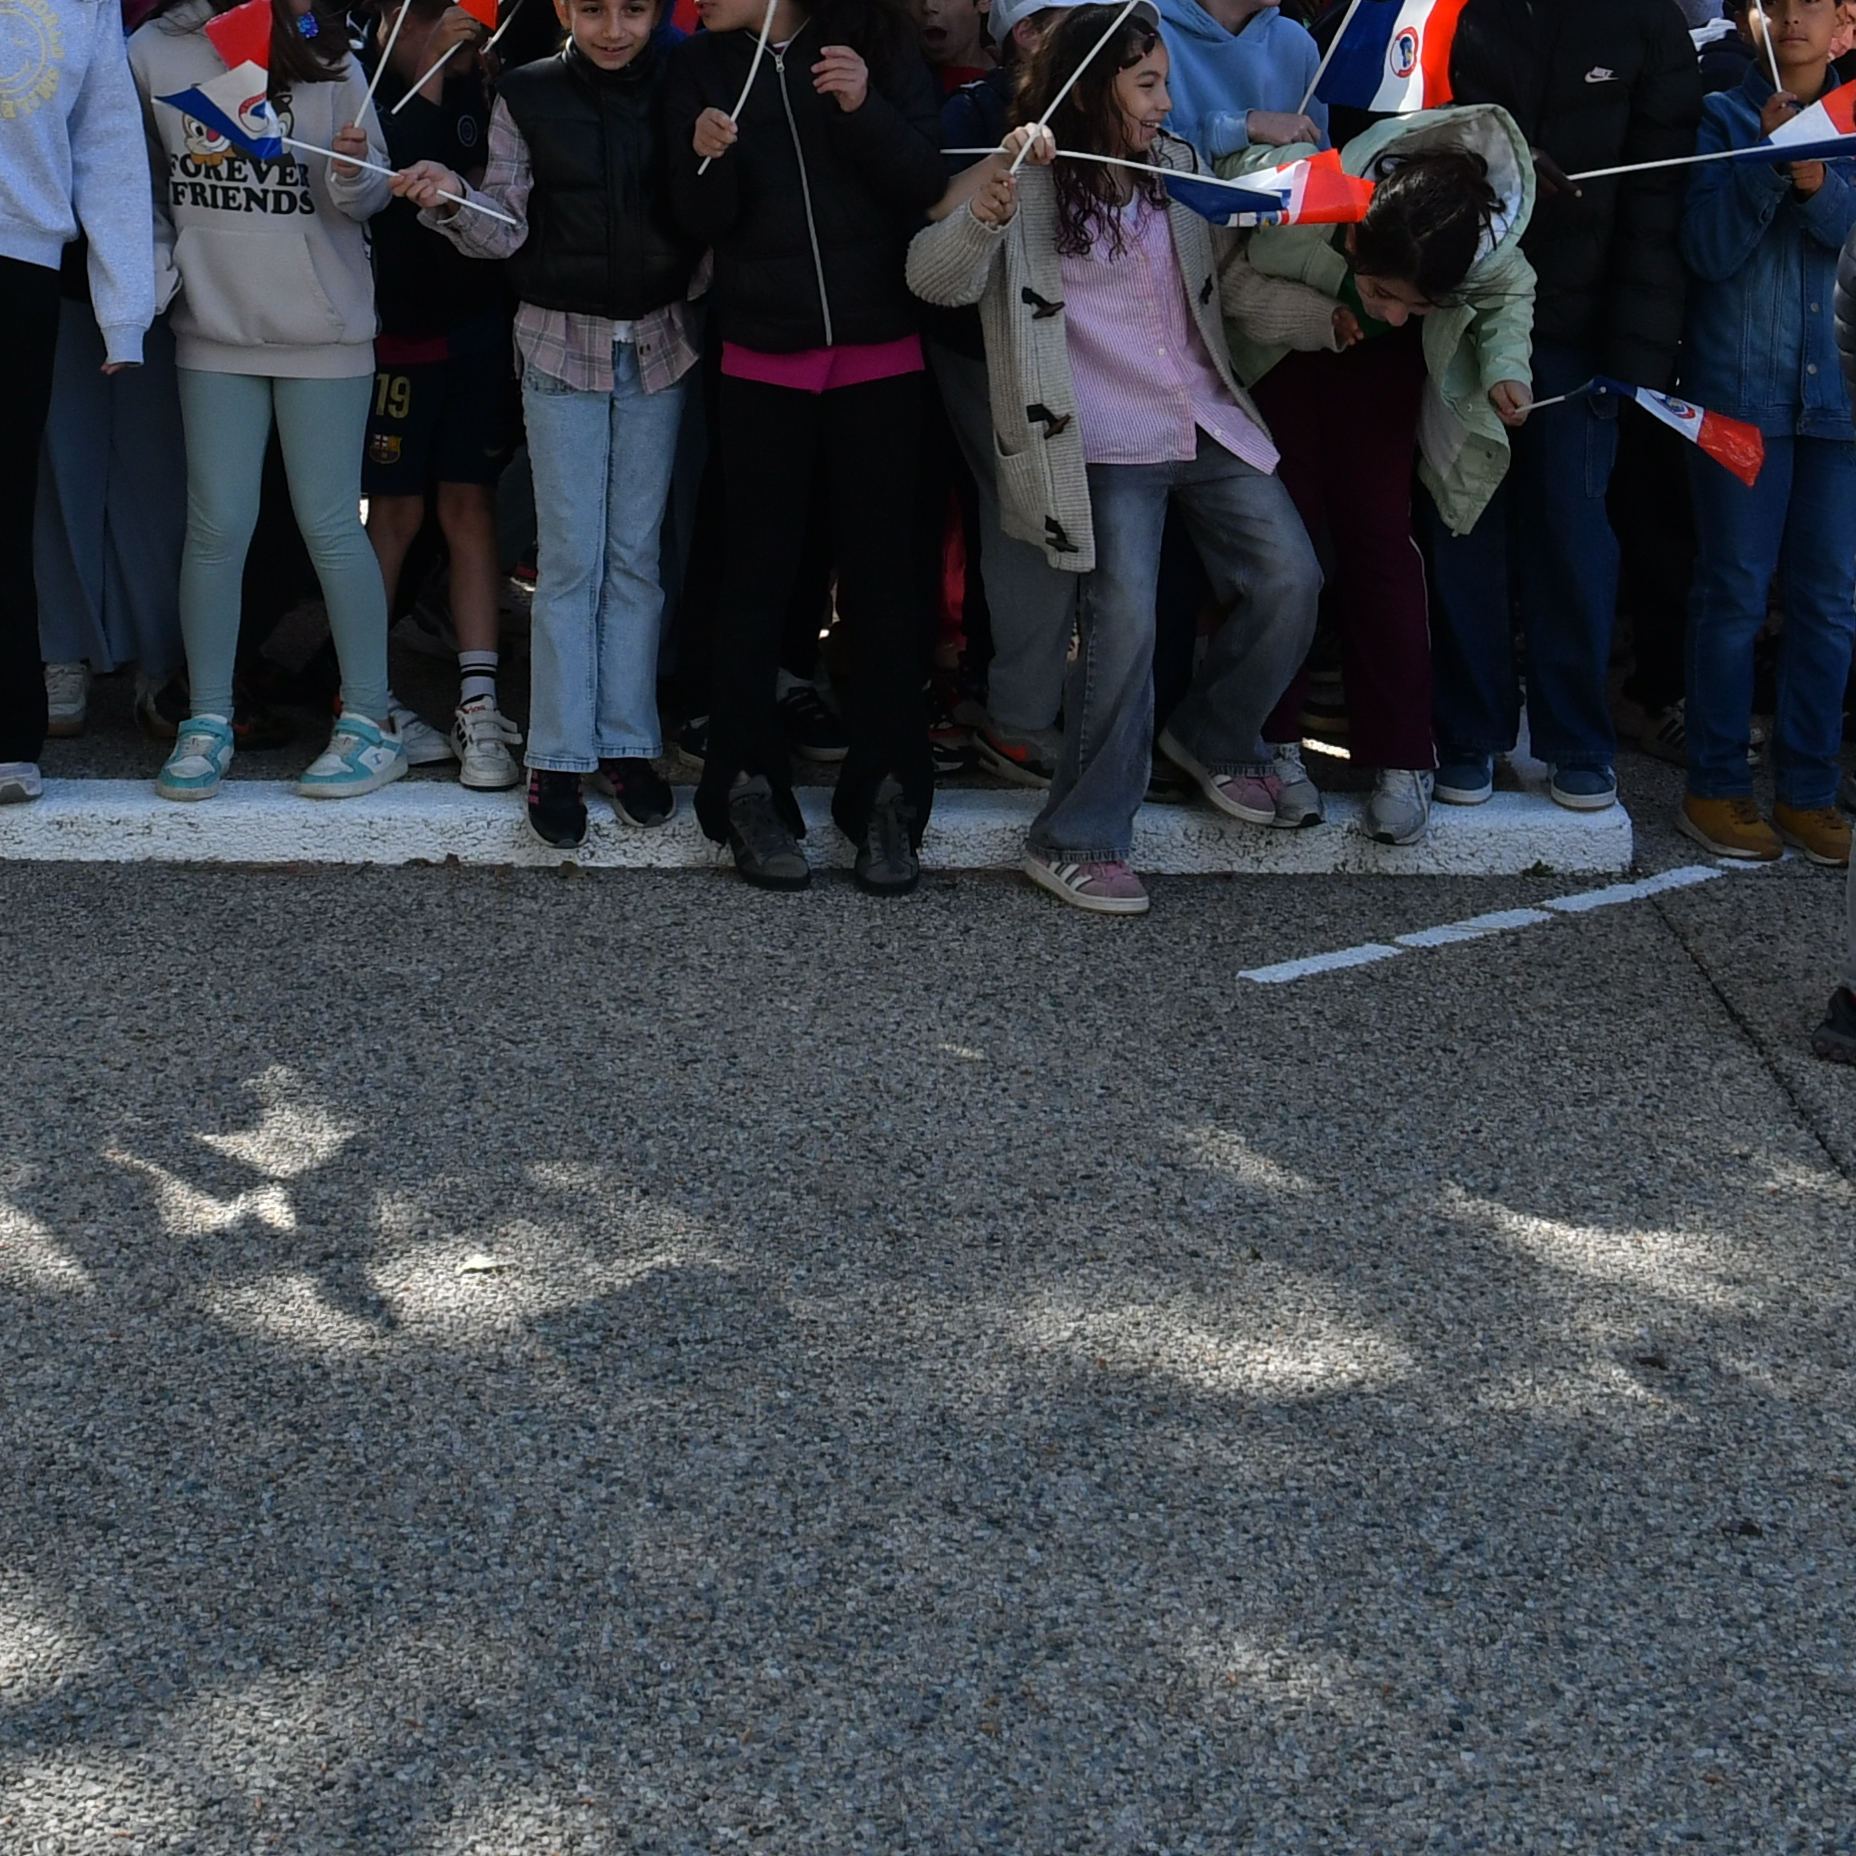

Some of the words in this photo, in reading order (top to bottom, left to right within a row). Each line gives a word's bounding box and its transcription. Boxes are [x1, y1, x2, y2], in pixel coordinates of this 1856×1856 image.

[169, 154, 311, 188] FOREVER
[171, 181, 315, 215] FRIENDS
[375, 373, 411, 419] 19
